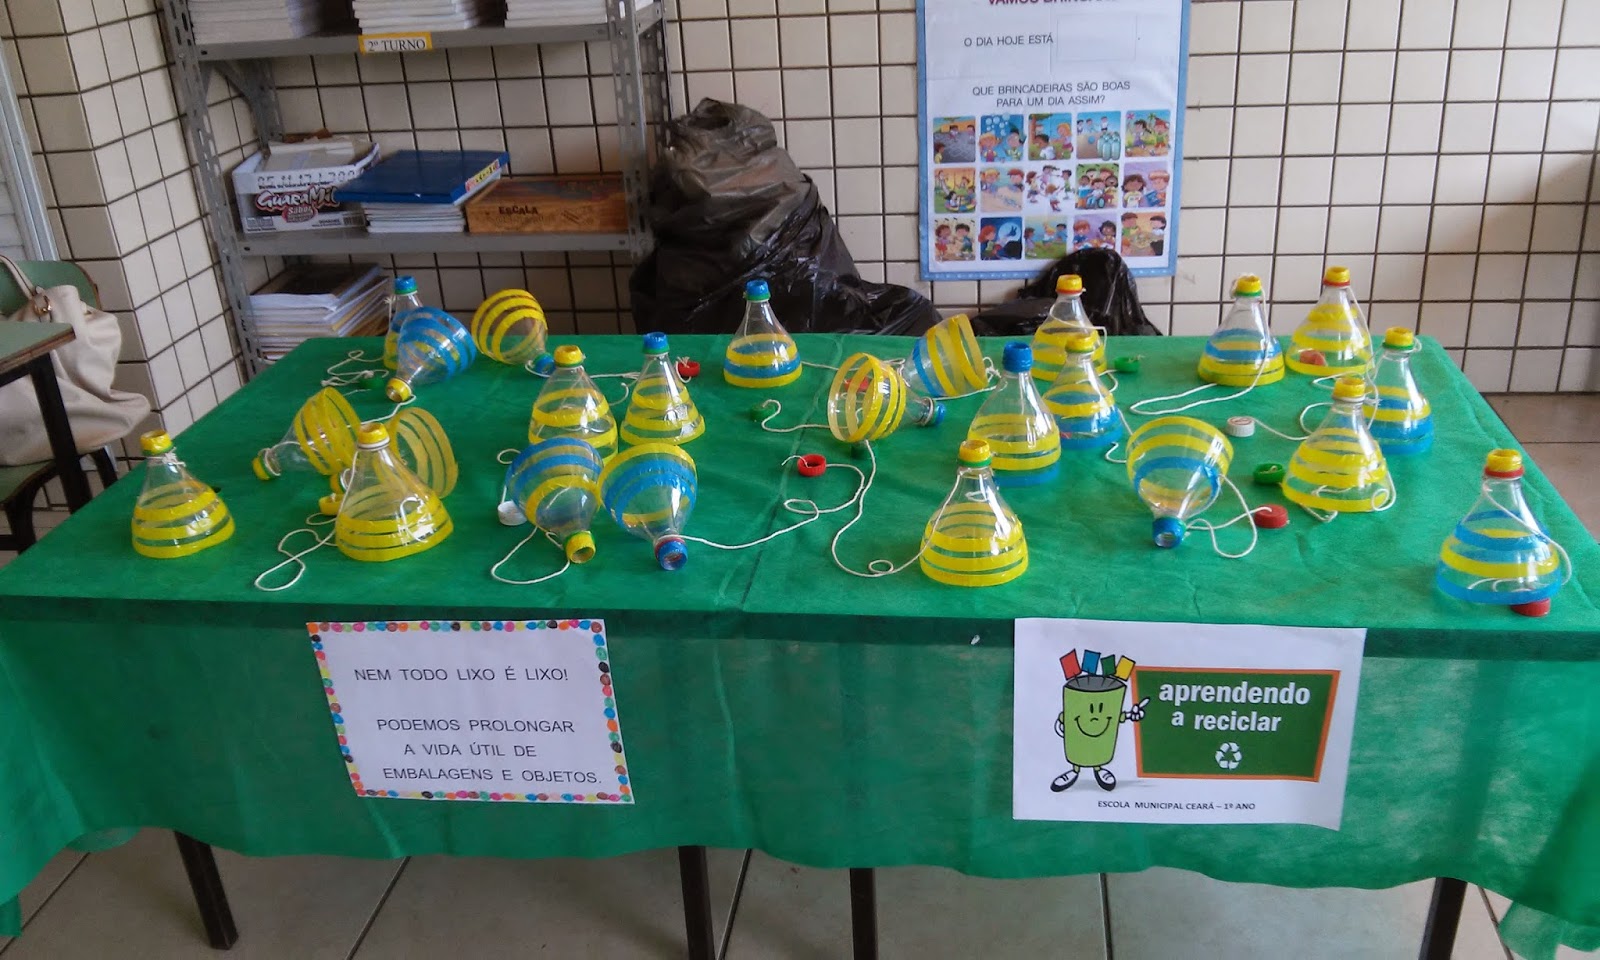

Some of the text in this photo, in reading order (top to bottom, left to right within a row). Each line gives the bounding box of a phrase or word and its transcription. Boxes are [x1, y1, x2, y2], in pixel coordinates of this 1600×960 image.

[382, 39, 426, 51] TURNO
[964, 33, 1054, 47] O DIA HOJE ESTÁ
[972, 81, 1131, 97] QUE BRINCADEIRAS SÃO BOAS
[996, 95, 1106, 108] PARA UM DIA ASSIM?
[499, 206, 539, 215] ESCALA
[354, 666, 569, 681] NEM TODO LIXO É LIXO!
[1158, 681, 1311, 706] aprendendo
[377, 719, 575, 733] PODEMOS PROLONGAR
[1171, 710, 1282, 732] a reciclar
[404, 741, 536, 757] A VIDA ÚTIL DE
[383, 768, 602, 784] EMBALAGENS E OBJETOS.
[1097, 800, 1130, 809] ESCOLA
[1134, 801, 1184, 810] MUNICIPAL
[1185, 801, 1215, 811] CEARÁ
[1235, 802, 1256, 811] ANO
